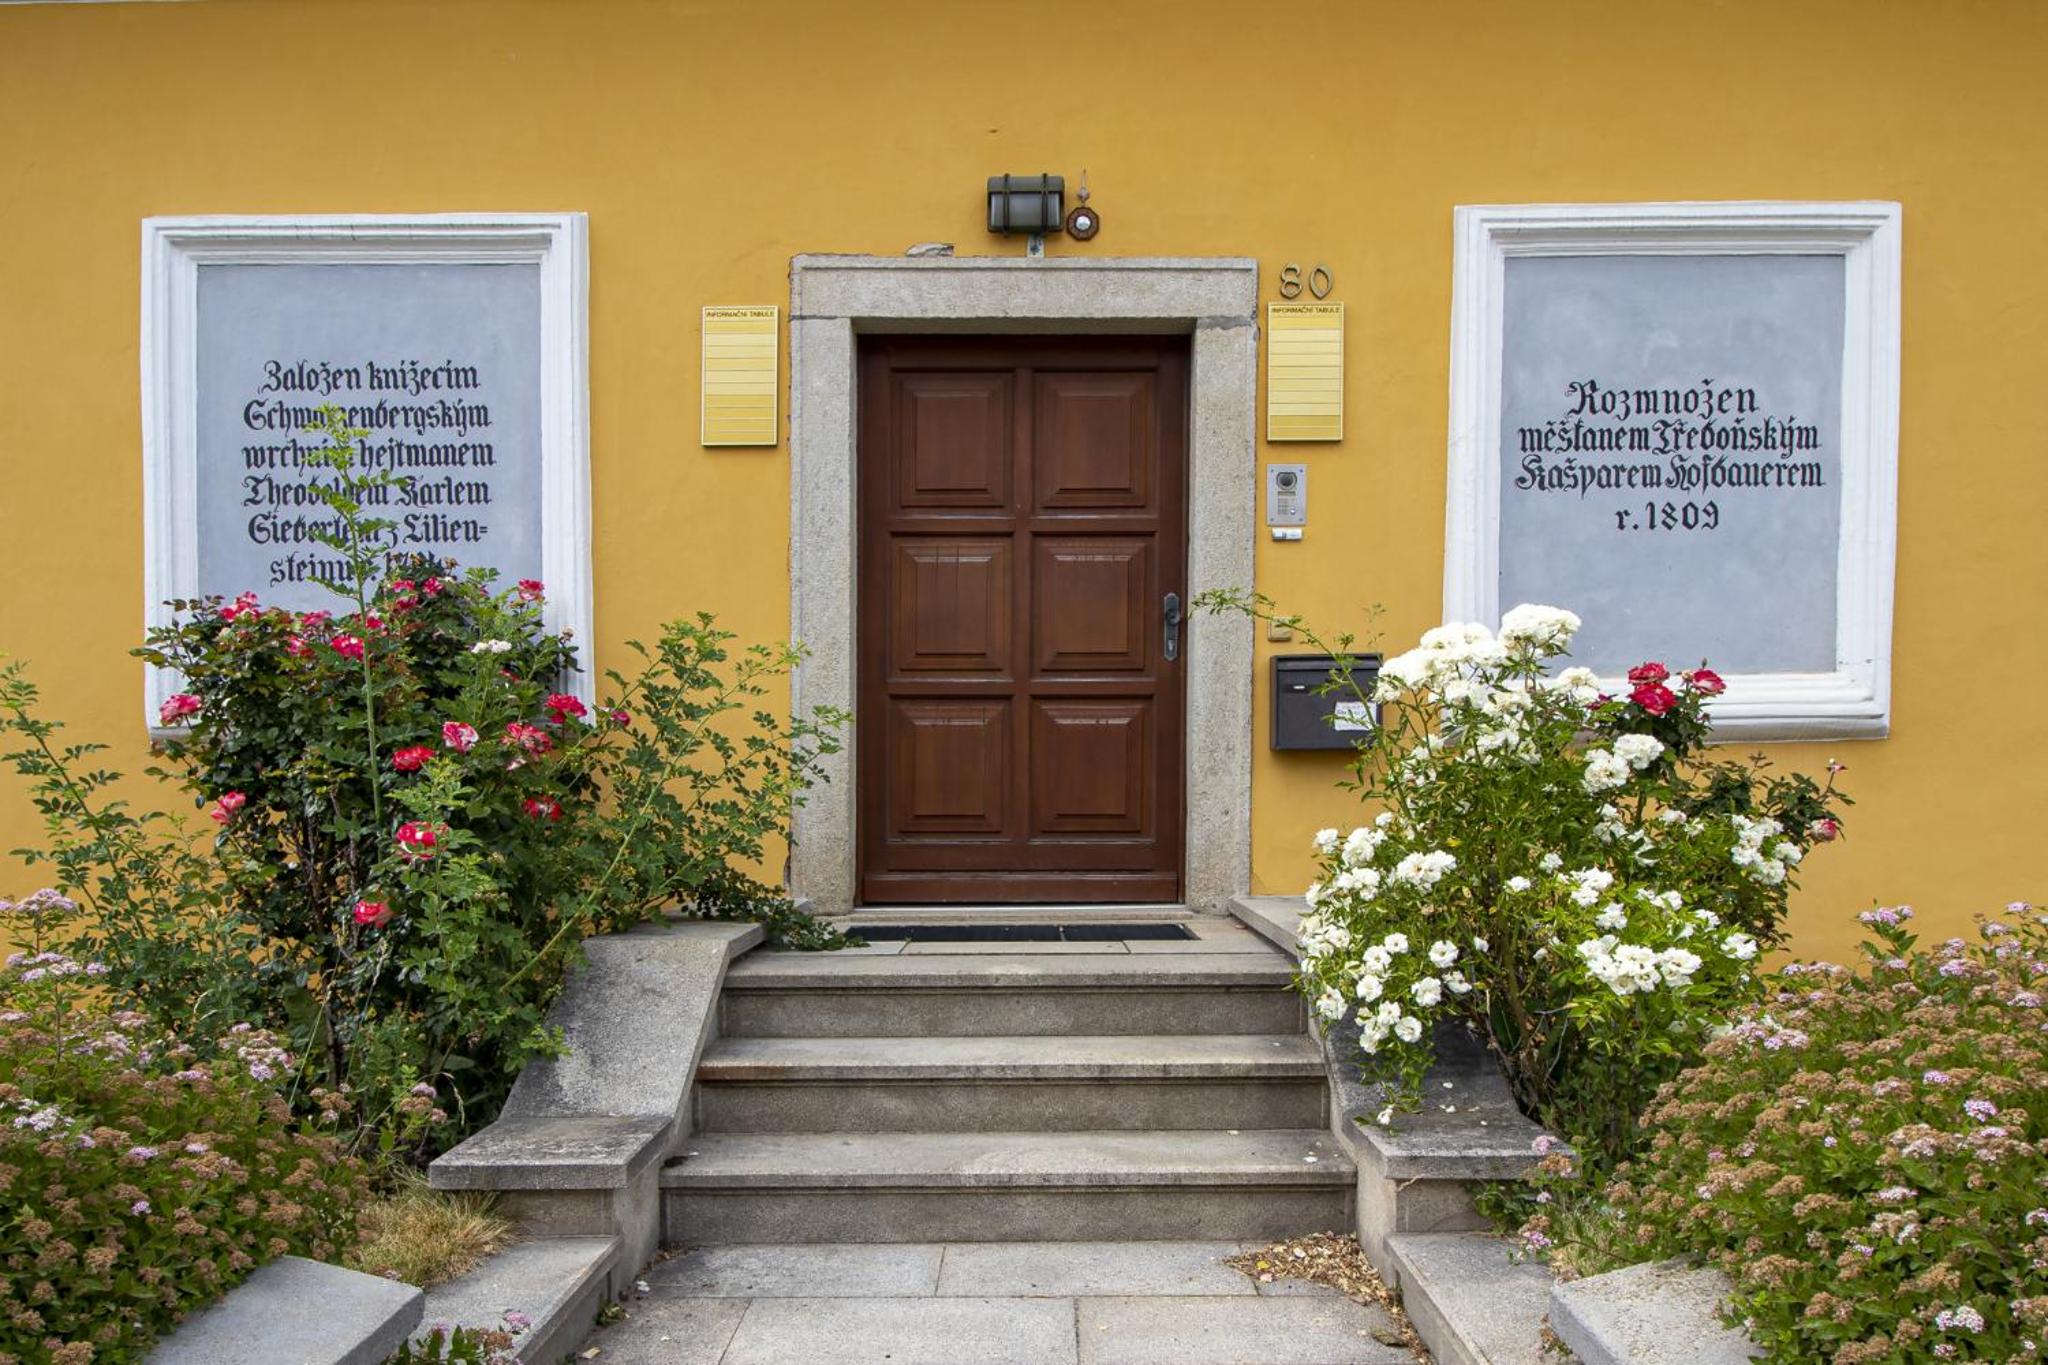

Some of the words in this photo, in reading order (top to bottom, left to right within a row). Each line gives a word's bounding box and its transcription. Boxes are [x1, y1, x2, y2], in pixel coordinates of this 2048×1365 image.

[1280, 263, 1333, 300] 80
[257, 359, 363, 397] Založen
[243, 398, 493, 438] Schwaenbergským
[1565, 379, 1759, 420] Rozmnožen
[242, 438, 356, 477] wrchní
[354, 437, 497, 477] hejtmanem
[1515, 454, 1663, 500] Kašparem
[393, 474, 492, 508] Karlem
